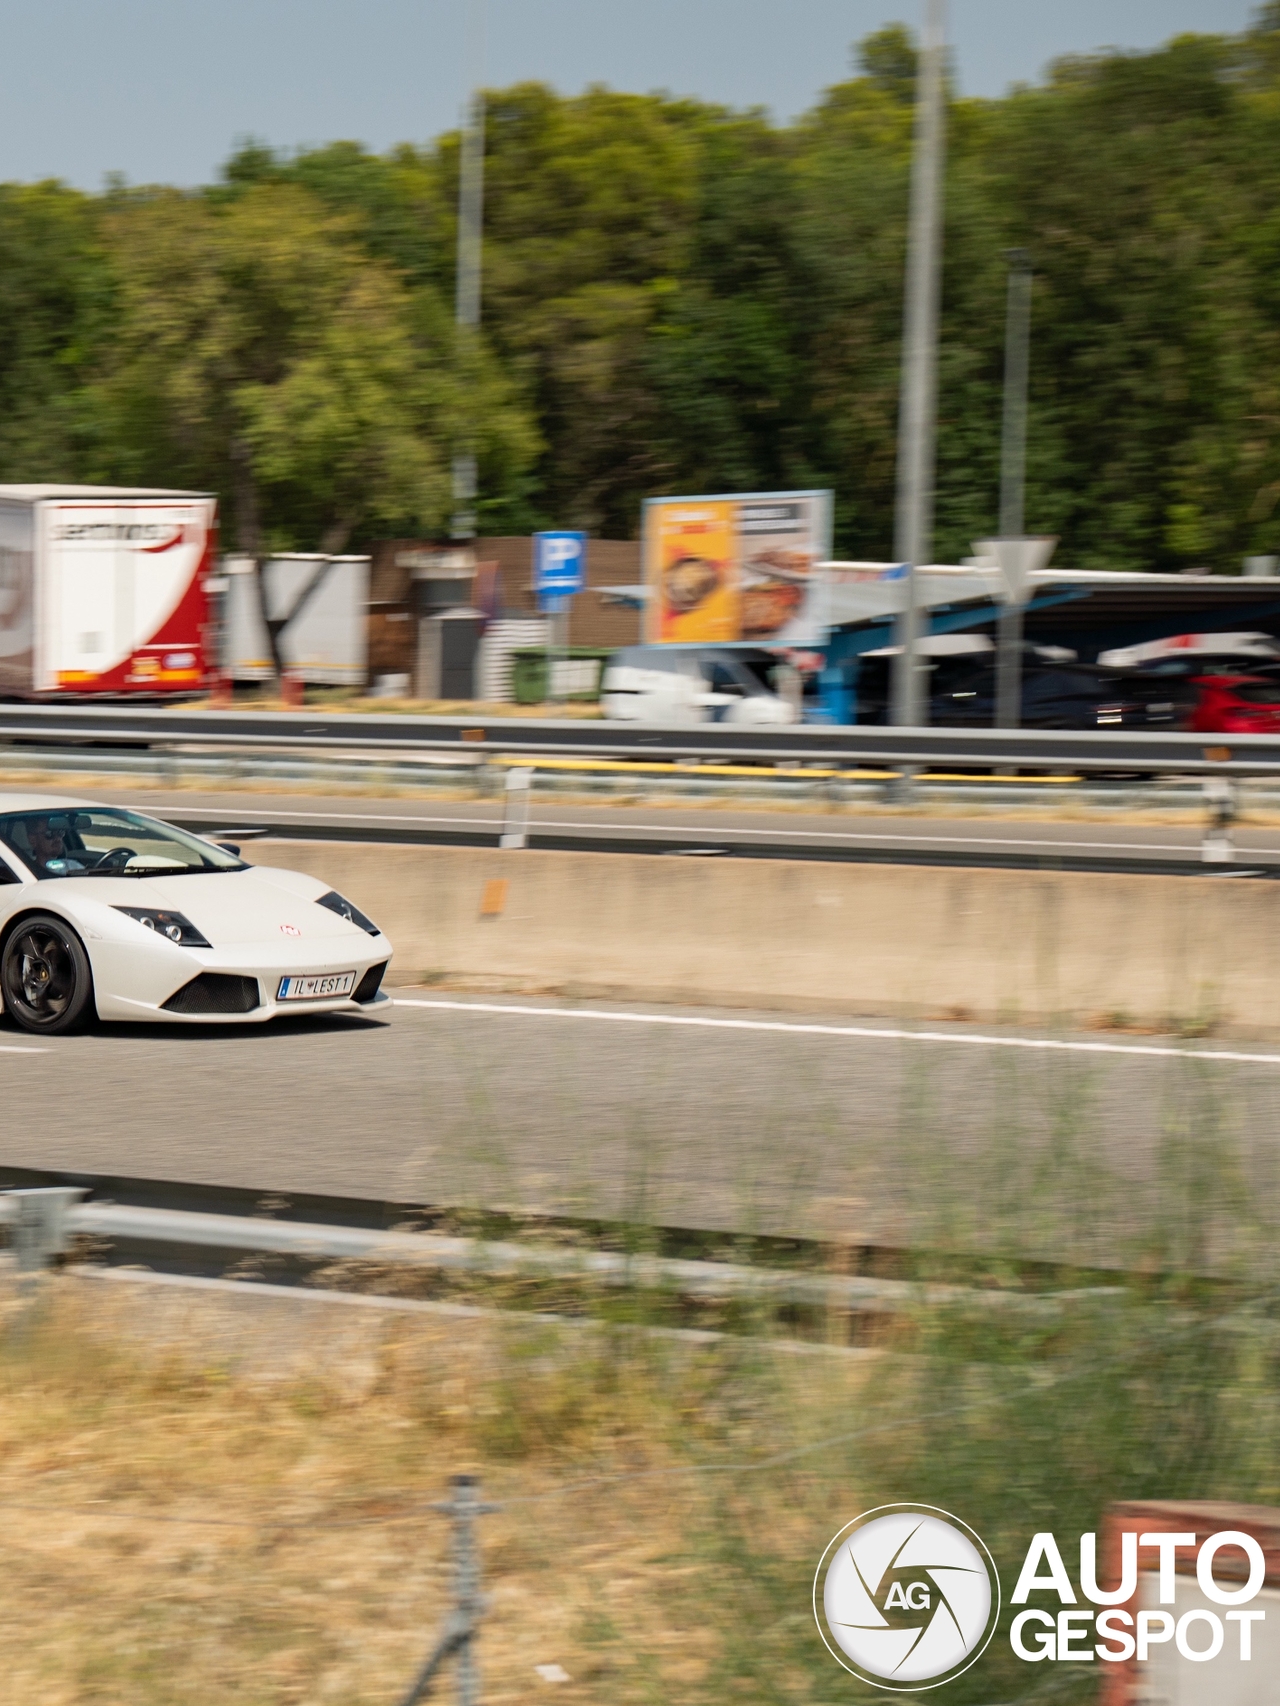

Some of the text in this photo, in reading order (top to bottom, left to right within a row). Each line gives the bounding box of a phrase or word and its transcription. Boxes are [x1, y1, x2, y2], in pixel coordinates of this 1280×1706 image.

[540, 538, 582, 571] P
[294, 976, 348, 994] IL LEST 1
